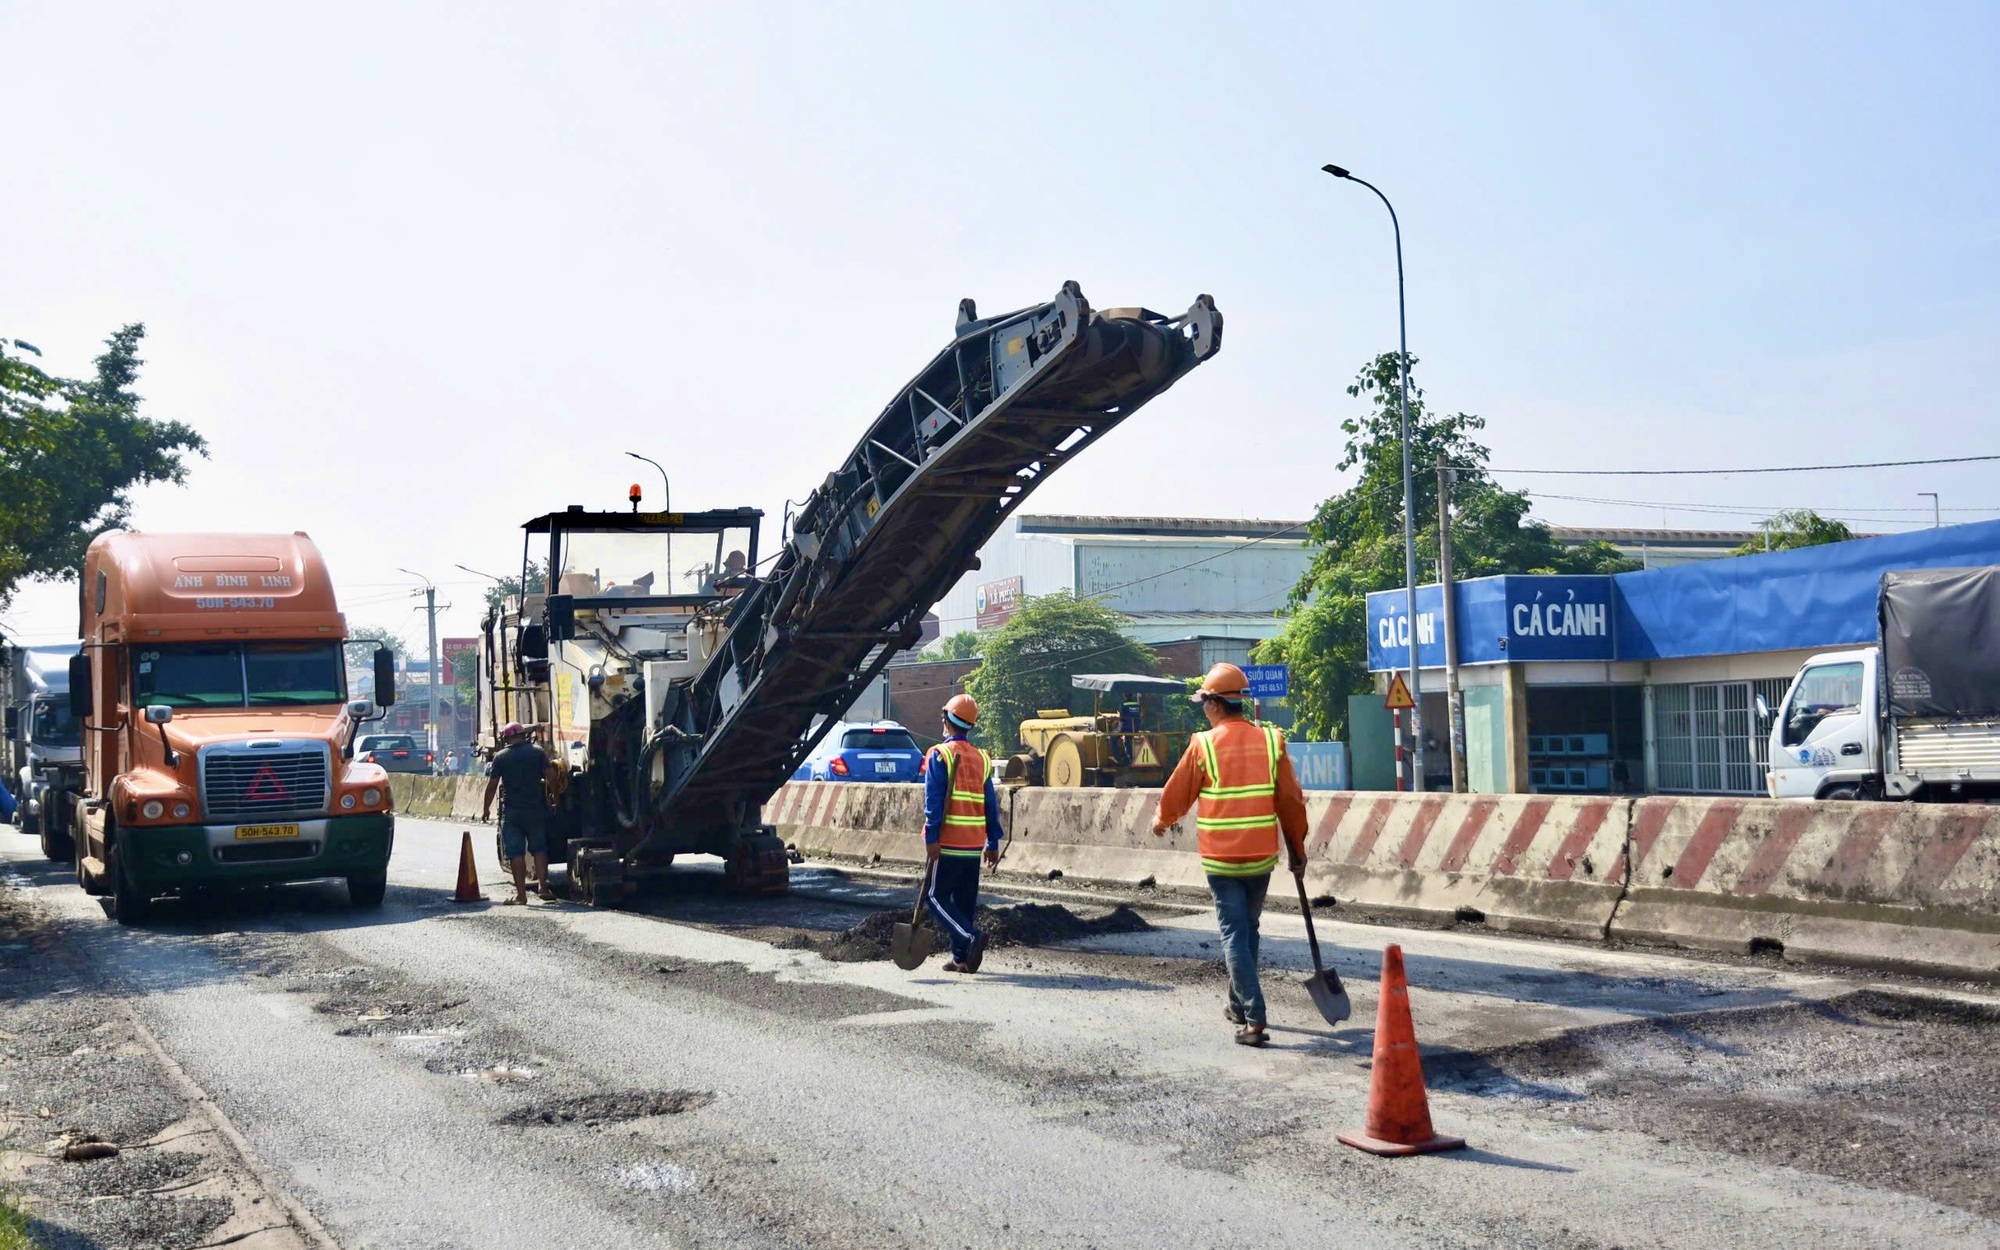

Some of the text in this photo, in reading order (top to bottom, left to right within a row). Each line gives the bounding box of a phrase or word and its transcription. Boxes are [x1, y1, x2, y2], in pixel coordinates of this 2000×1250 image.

[260, 575, 291, 588] LINH
[1513, 588, 1606, 636] CÁ CẢNH
[1379, 605, 1435, 648] CÁ CNH
[1264, 670, 1283, 680] QUAN
[241, 827, 294, 836] 50H-543.70
